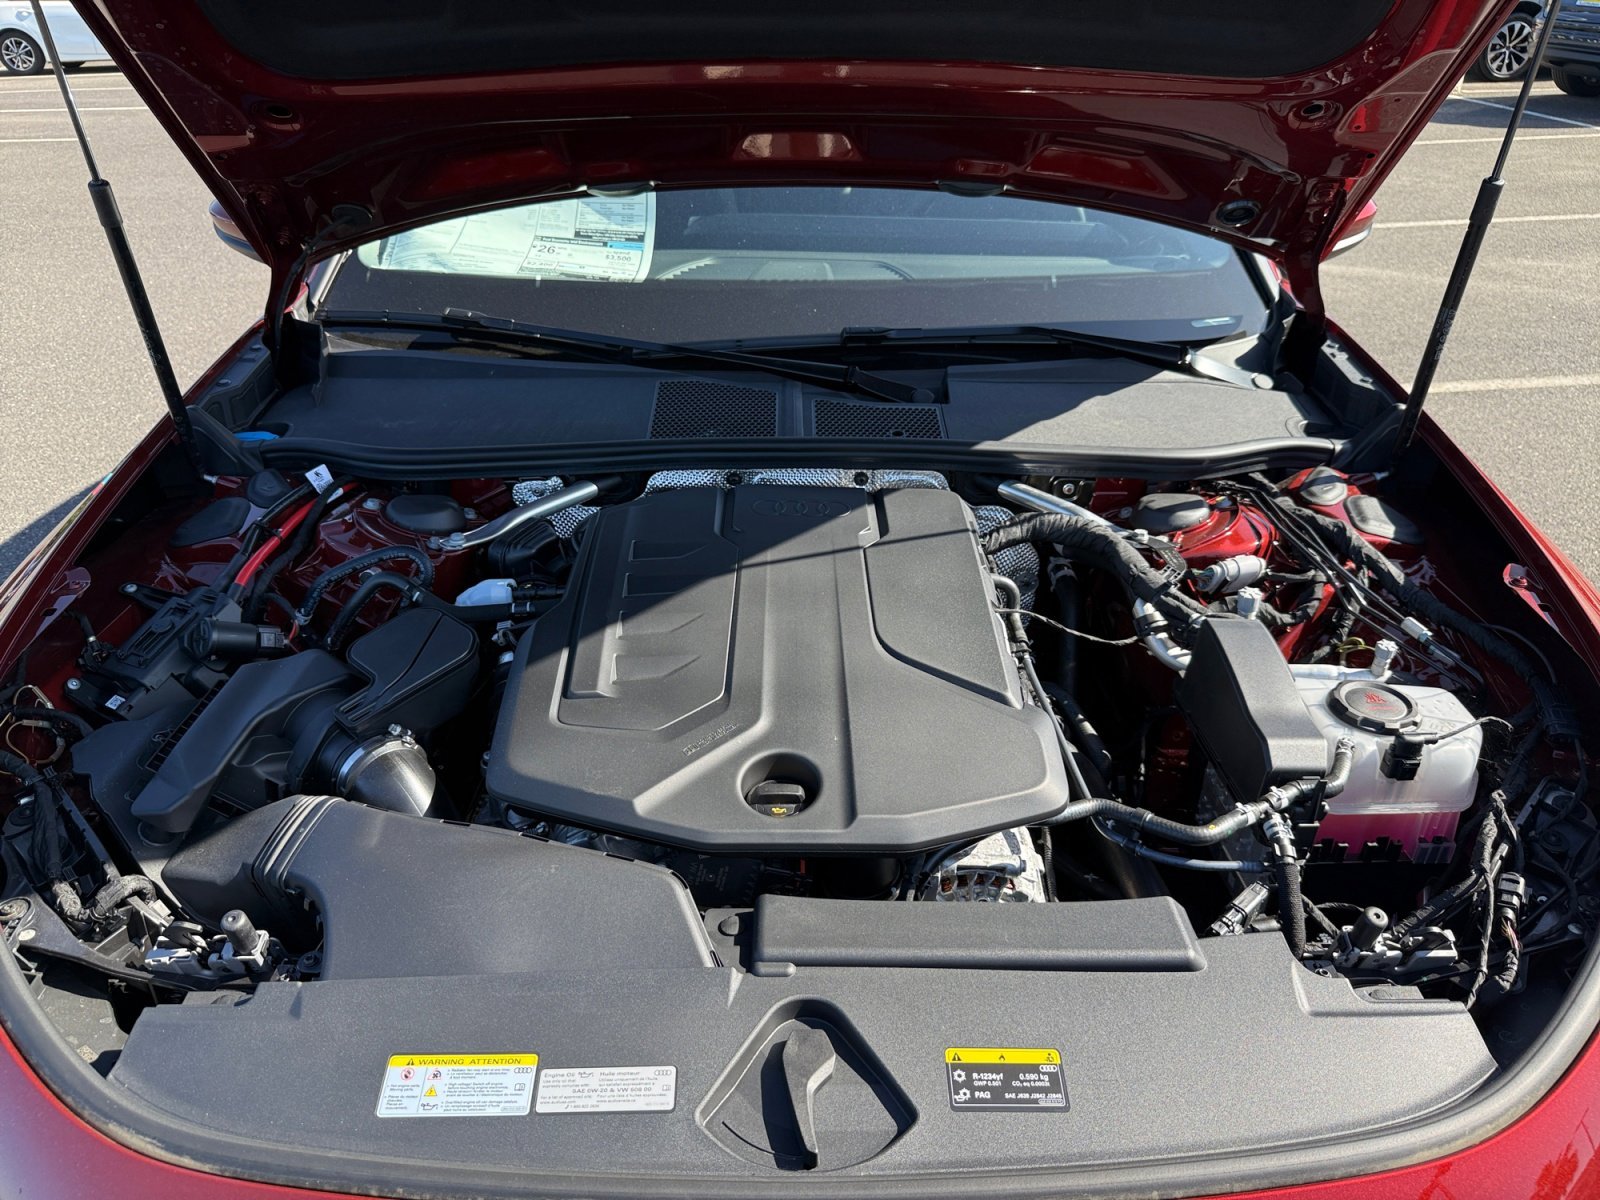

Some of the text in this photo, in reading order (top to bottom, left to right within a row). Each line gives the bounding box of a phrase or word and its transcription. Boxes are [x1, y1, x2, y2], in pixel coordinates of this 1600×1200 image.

[537, 245, 556, 254] 26
[972, 1073, 1003, 1081] R-1234yf
[1039, 1073, 1049, 1081] kg
